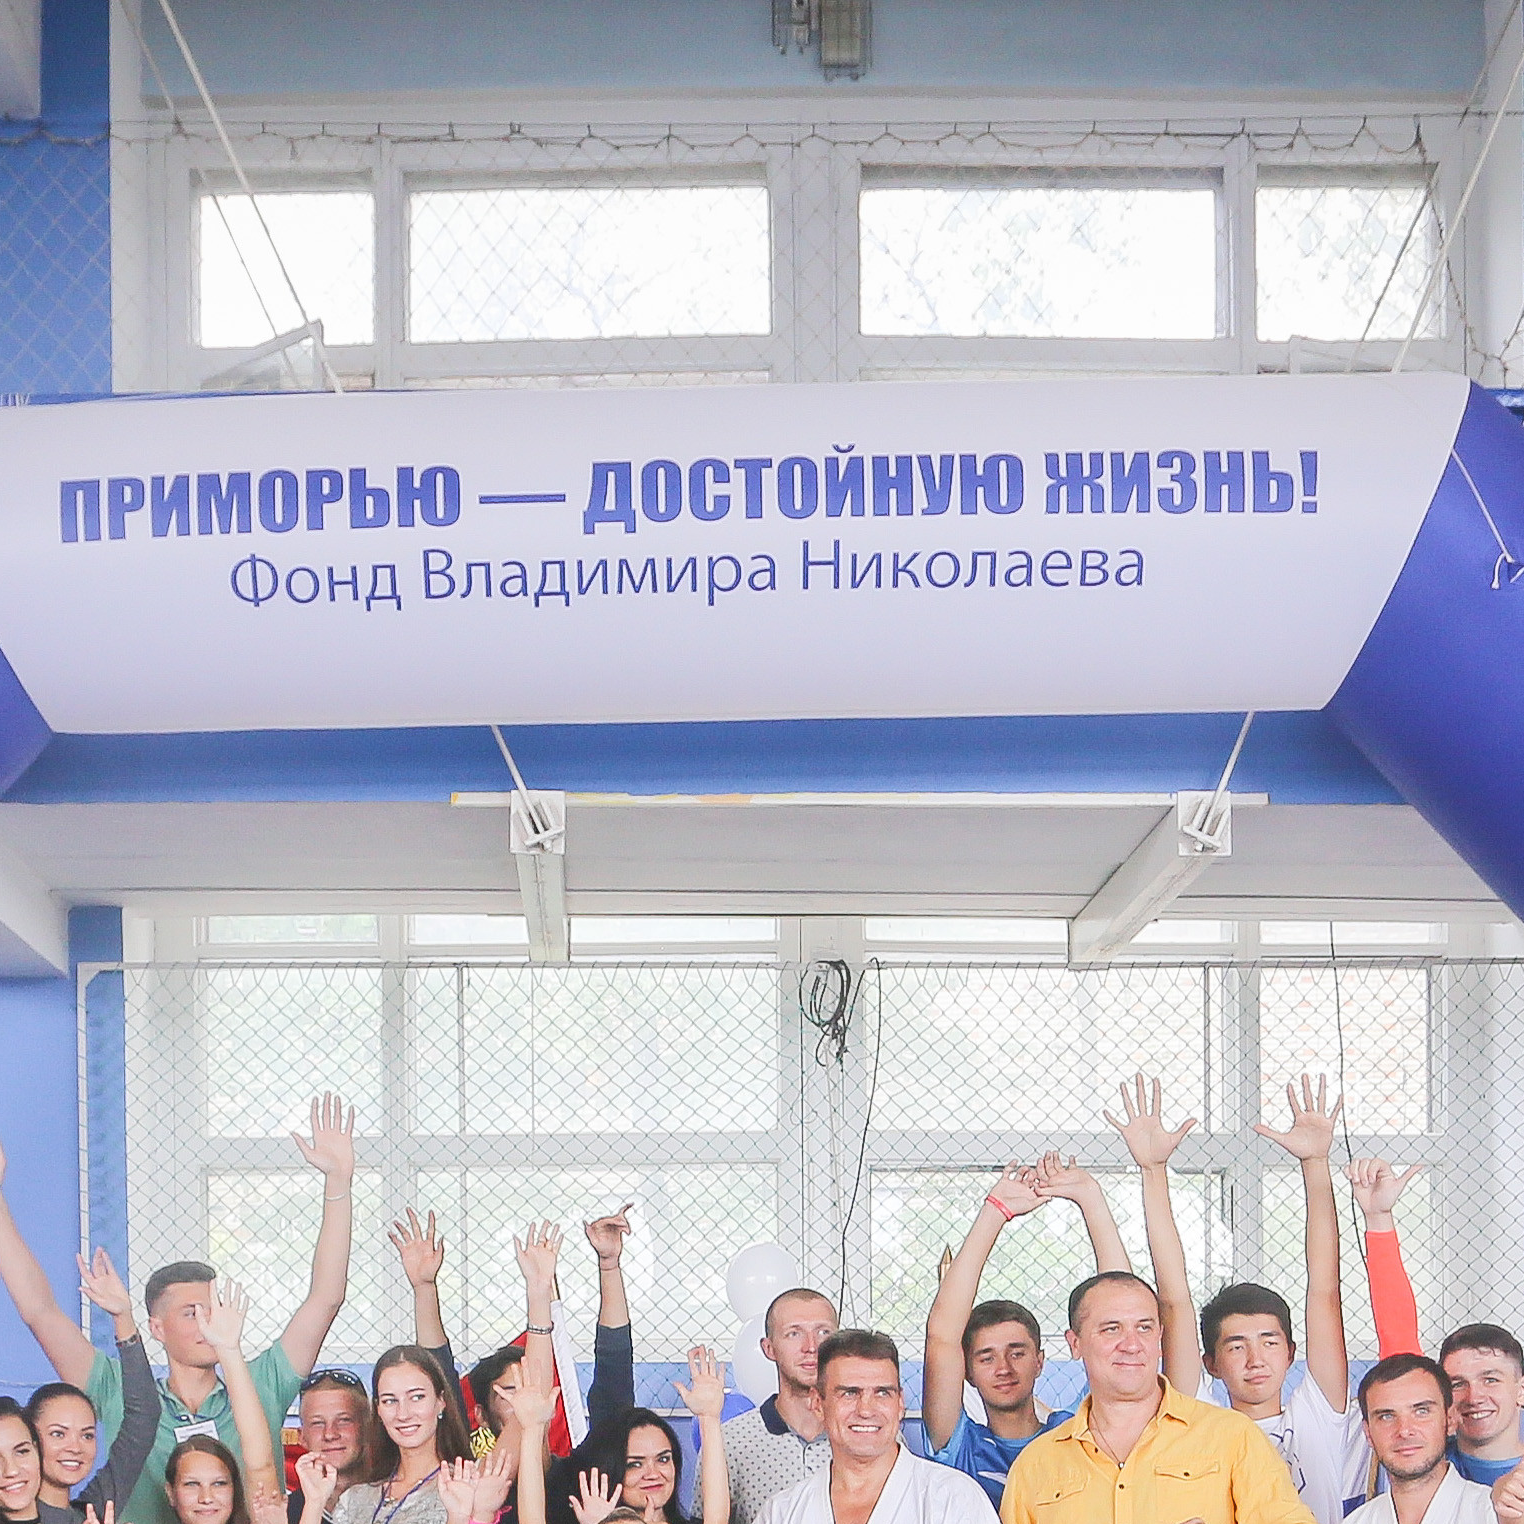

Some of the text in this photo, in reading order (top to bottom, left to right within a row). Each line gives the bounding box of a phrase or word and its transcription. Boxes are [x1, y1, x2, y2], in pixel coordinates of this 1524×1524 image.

[60, 466, 460, 542] ПРИМОРЬЮ
[583, 444, 1024, 534] ДОСТОЙНУЮ
[1045, 450, 1319, 515] ЖИЗНЬ!
[231, 540, 1144, 612] Фонд Владимира Николаева
